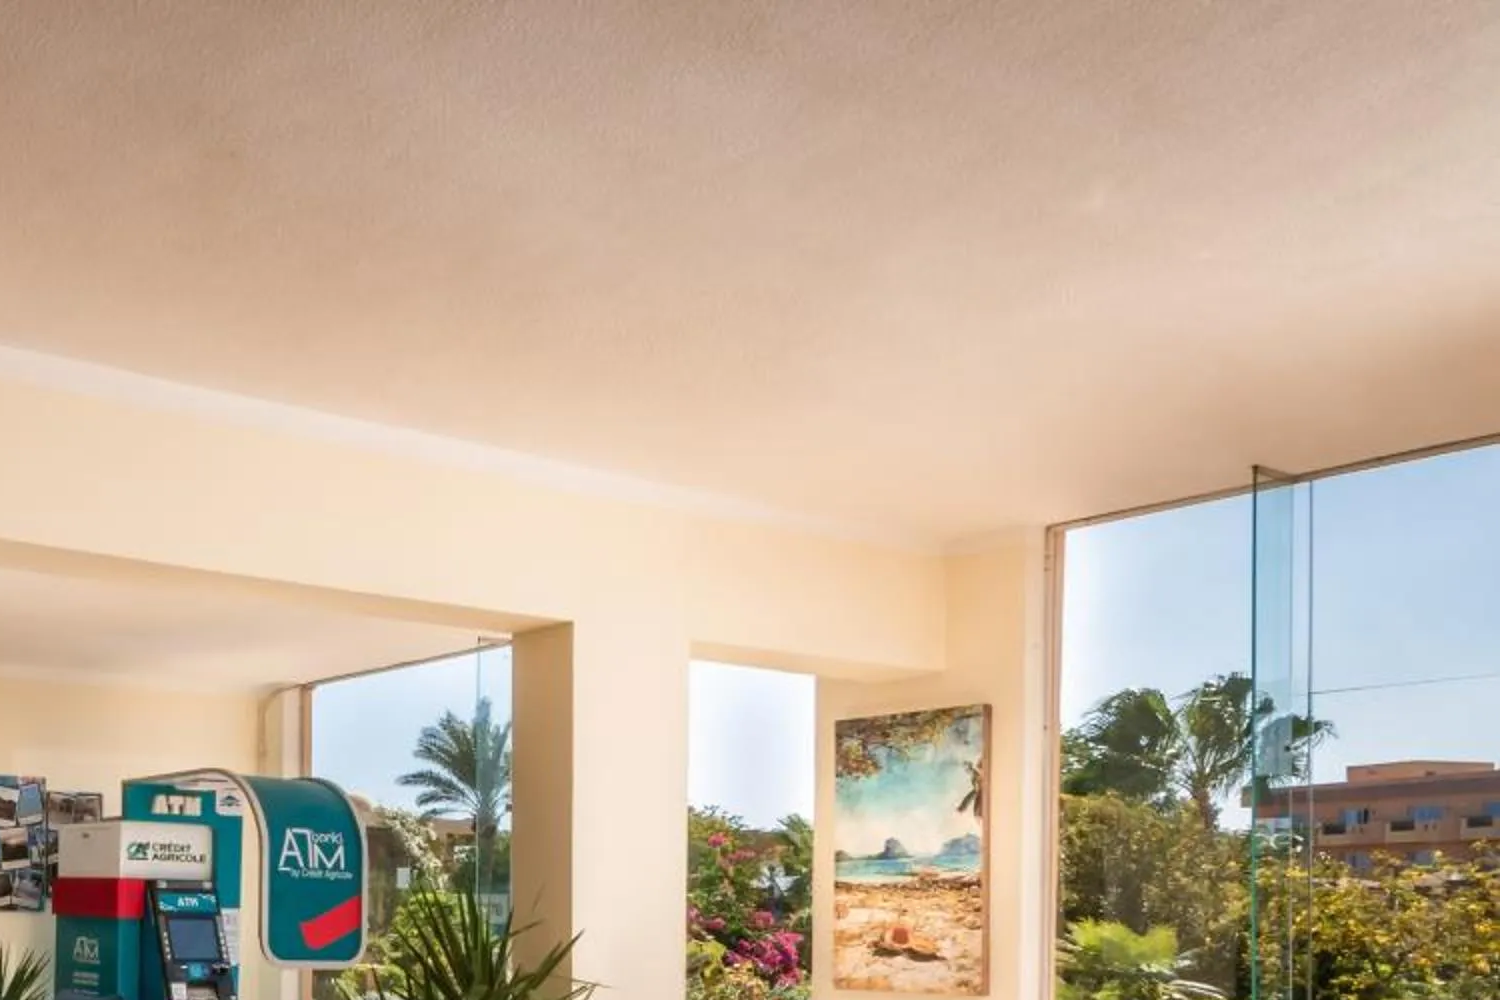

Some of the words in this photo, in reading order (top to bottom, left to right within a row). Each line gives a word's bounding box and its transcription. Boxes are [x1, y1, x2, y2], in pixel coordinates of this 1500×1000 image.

[152, 795, 202, 817] ATM
[151, 853, 207, 864] AGRICOLE
[279, 827, 345, 870] ATM
